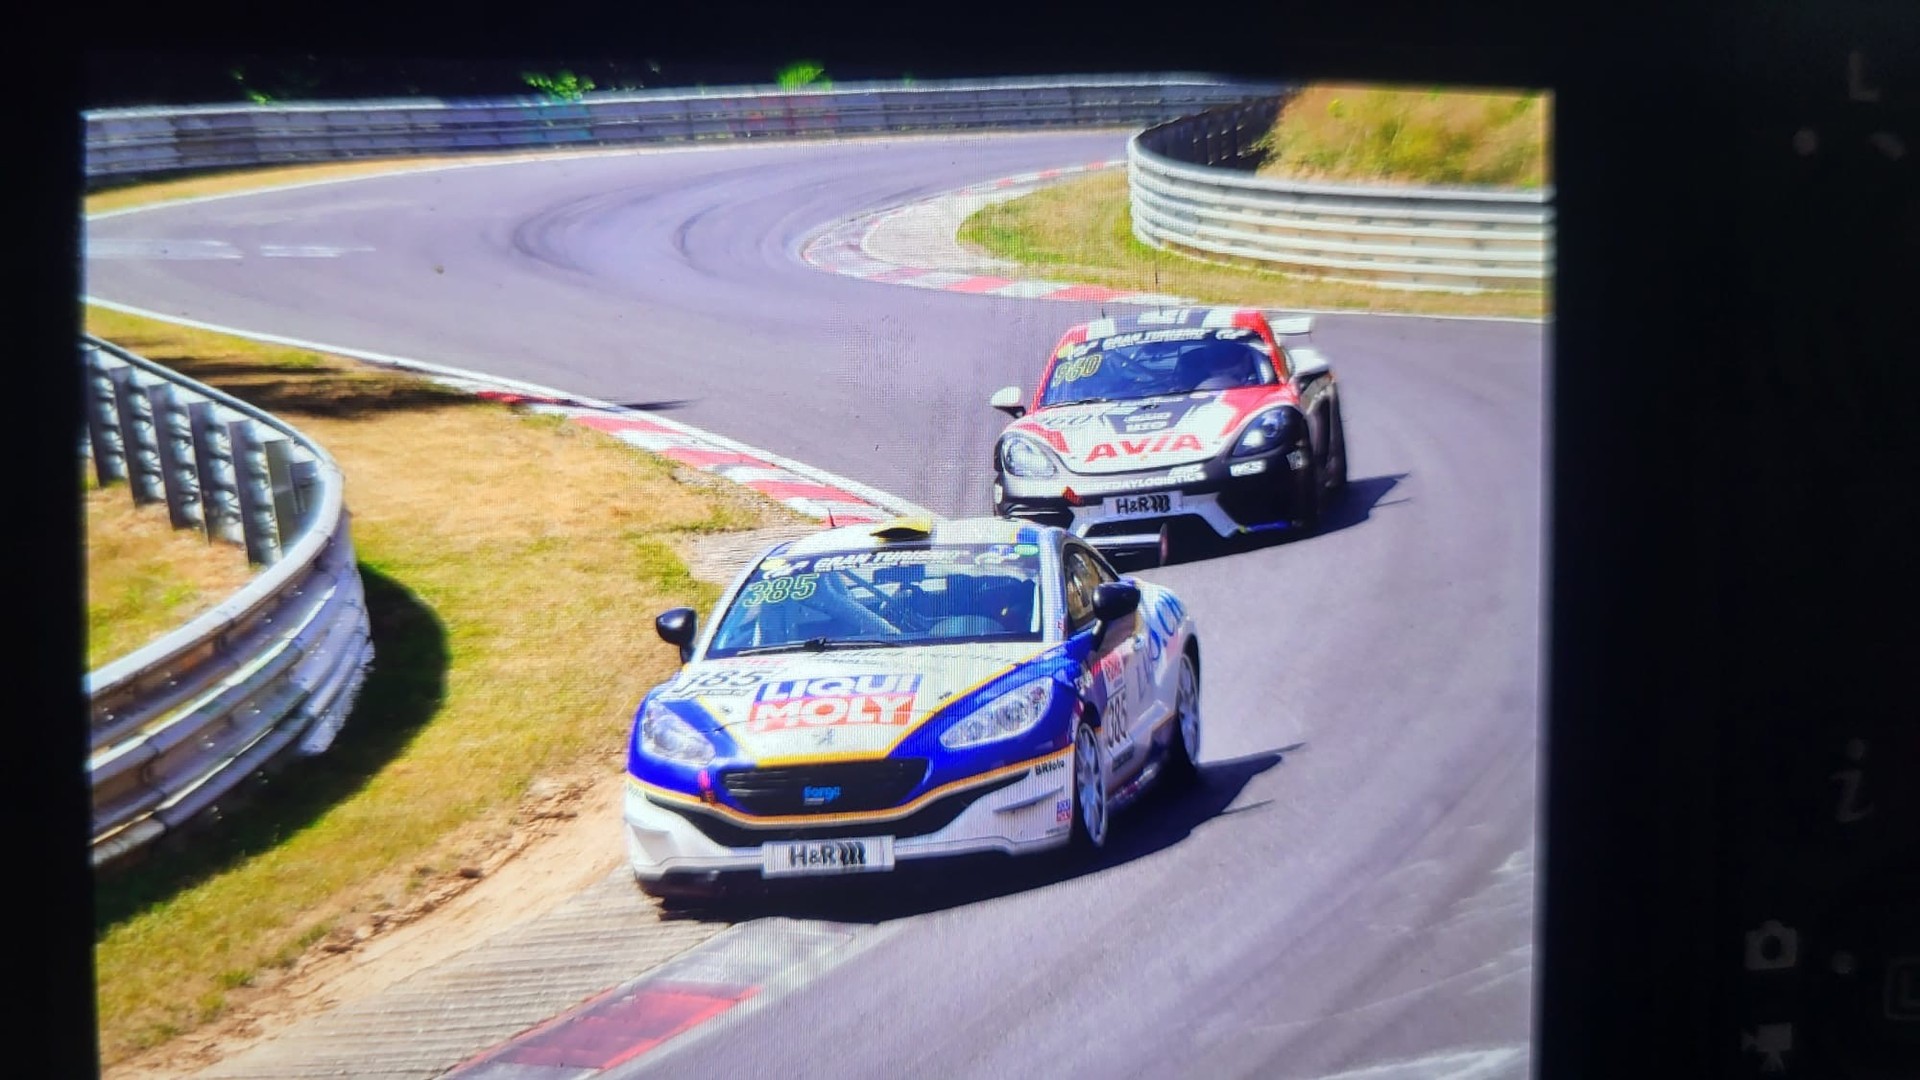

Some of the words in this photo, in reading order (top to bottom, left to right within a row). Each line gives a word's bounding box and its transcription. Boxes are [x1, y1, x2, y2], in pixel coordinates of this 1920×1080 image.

[1084, 434, 1204, 463] AVIA
[1115, 495, 1151, 514] H&R
[814, 554, 873, 572] GRAN
[874, 549, 961, 567] TURISMO
[743, 575, 819, 606] 385
[761, 674, 920, 700] LIQUI
[753, 695, 913, 731] MOLY
[789, 843, 838, 868] H&R
